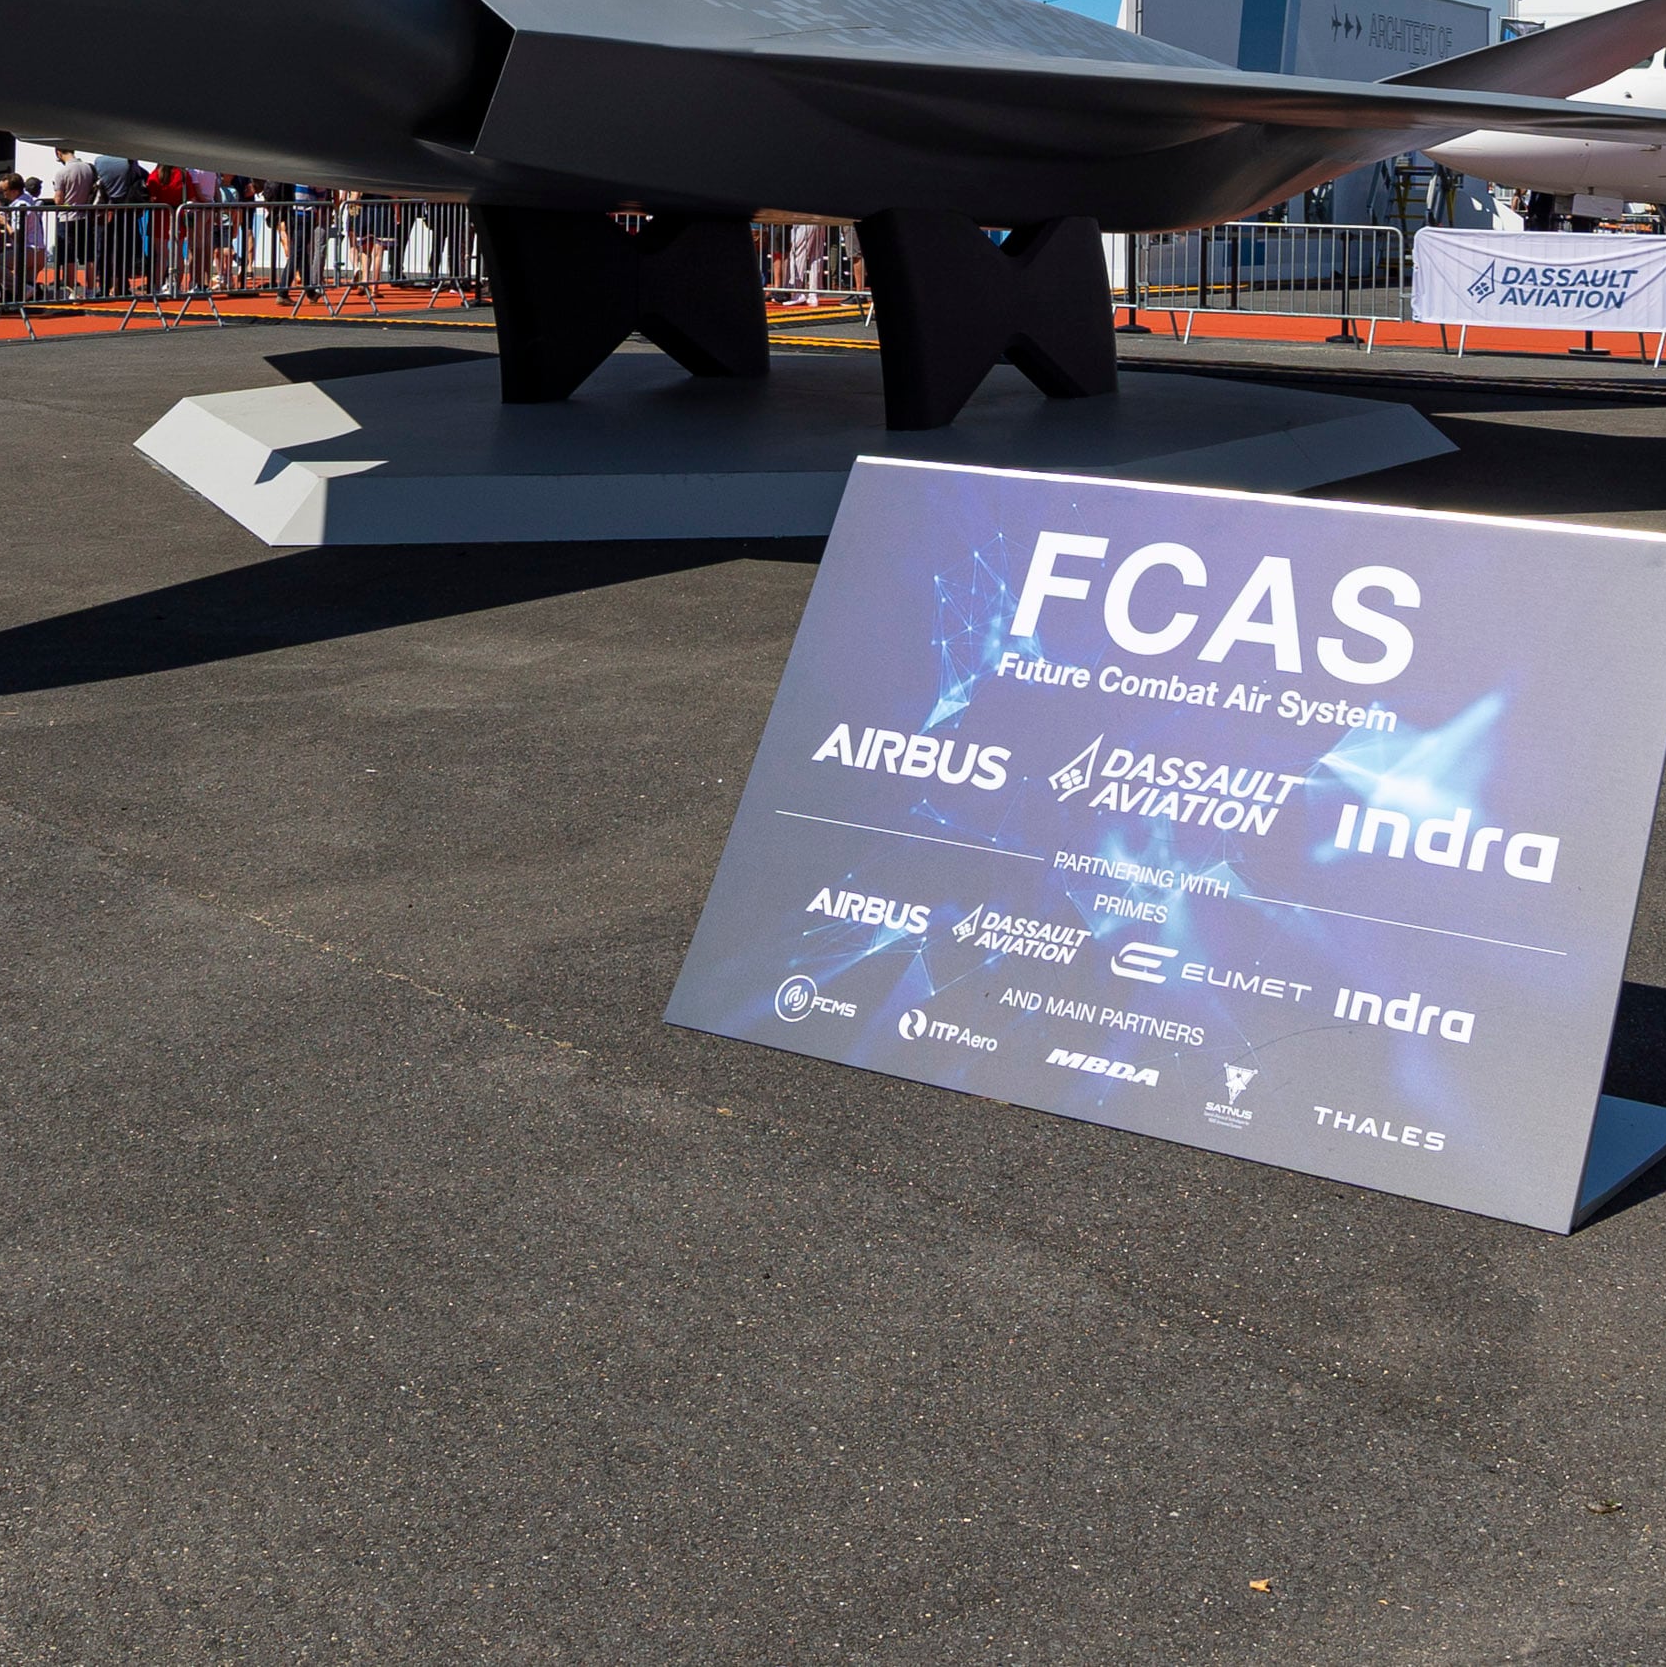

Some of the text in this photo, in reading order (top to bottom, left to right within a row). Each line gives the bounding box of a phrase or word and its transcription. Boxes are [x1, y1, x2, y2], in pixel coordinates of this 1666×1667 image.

[1369, 12, 1453, 59] ARCHITECT OF
[1499, 285, 1627, 310] AVIATION
[1500, 265, 1639, 289] DASSAULT
[1009, 530, 1422, 685] FCAS
[997, 651, 1398, 732] Future Combat Air System
[811, 723, 1012, 791] AIRBUS
[1100, 747, 1310, 806] DASSAULT
[1089, 781, 1279, 836] AVIATION
[1333, 803, 1561, 884] indra
[1053, 850, 1230, 899] PARTNERING WITH
[805, 887, 932, 934] AIRBUS
[981, 911, 1092, 948] DASSAULT
[1093, 893, 1168, 924] PRIMES
[974, 930, 1078, 965] AVIATION
[1179, 961, 1312, 1003] EUMET
[810, 995, 857, 1017] FCMS
[999, 987, 1205, 1047] AND MAIN PARTNERS
[1333, 987, 1476, 1044] indra
[1045, 1048, 1160, 1087] MBDA
[1205, 1101, 1253, 1120] SATNUS
[1313, 1104, 1446, 1152] THALES
